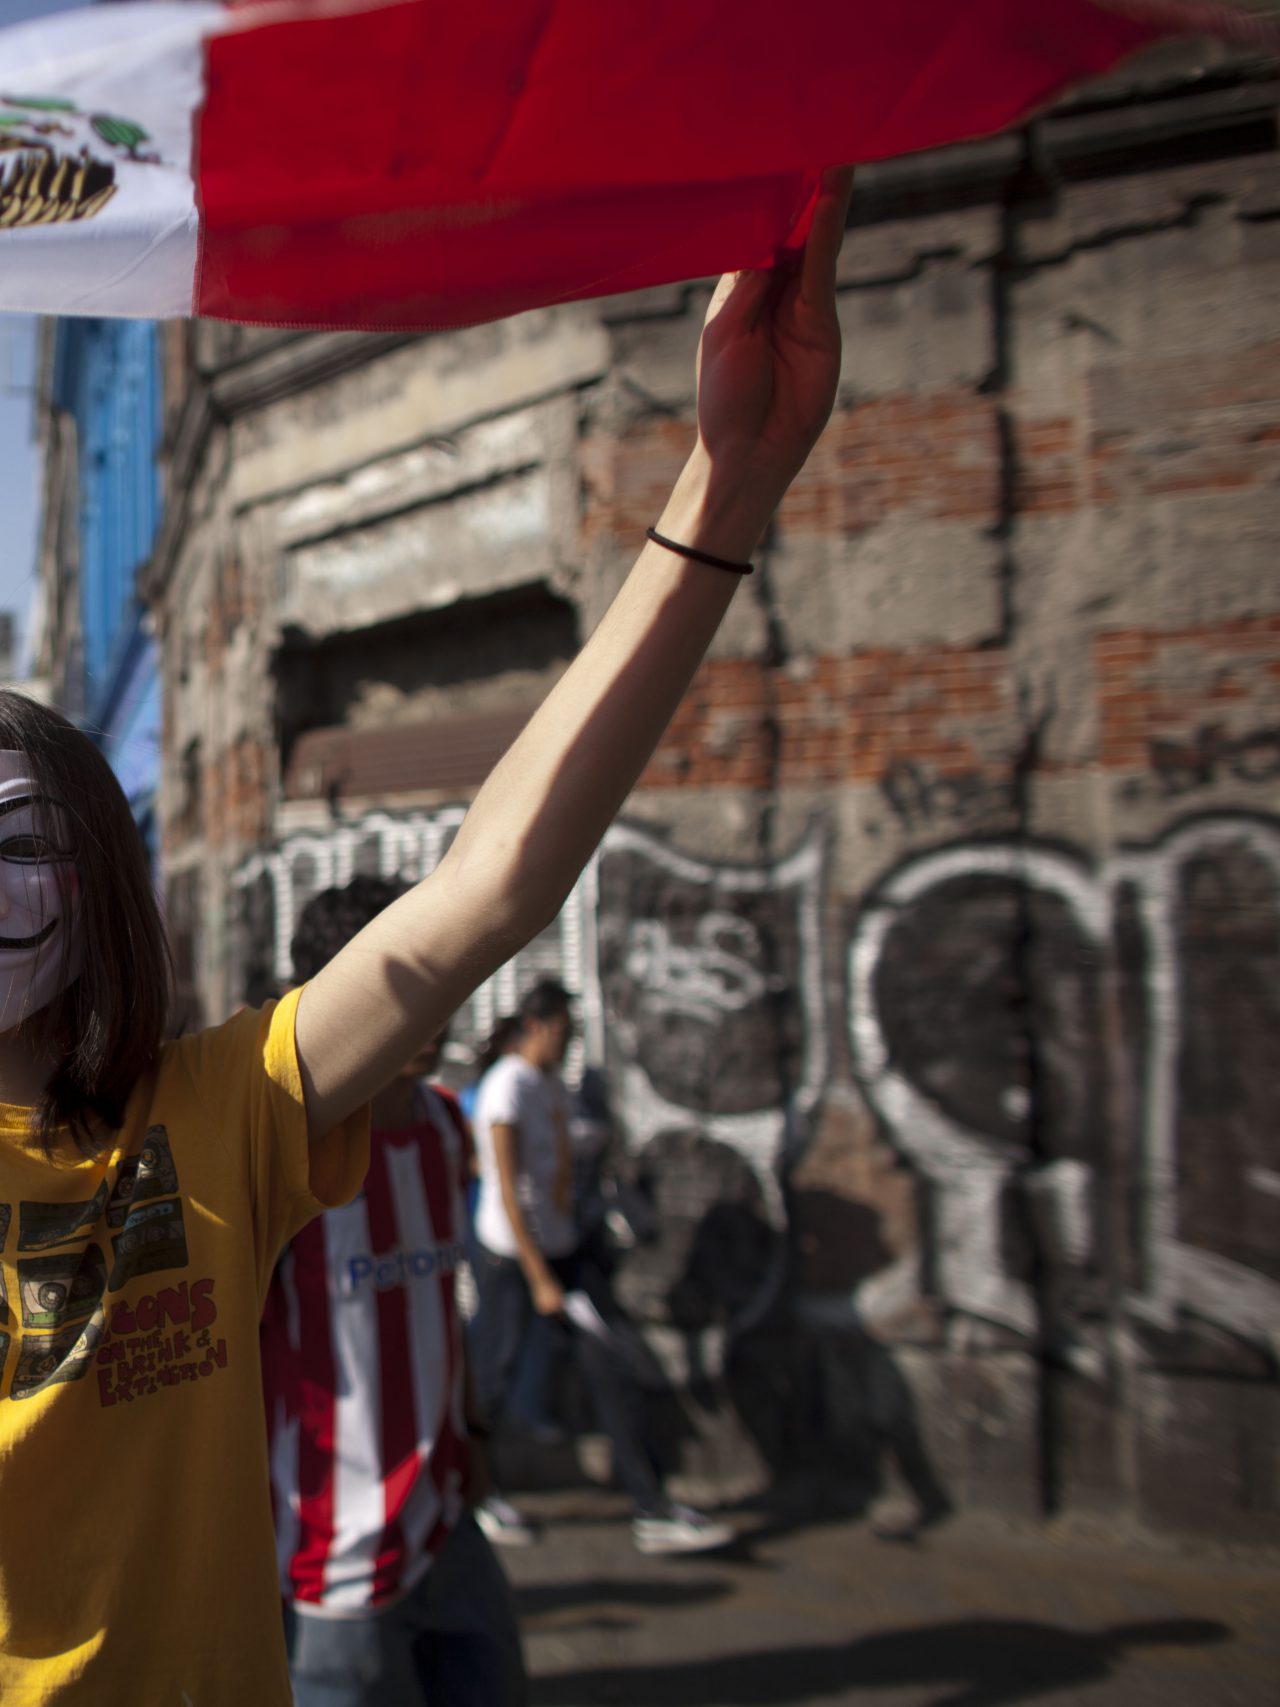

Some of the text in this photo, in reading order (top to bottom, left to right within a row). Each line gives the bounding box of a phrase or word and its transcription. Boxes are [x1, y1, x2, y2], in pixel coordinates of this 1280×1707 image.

[96, 1329, 163, 1365] ON THE
[117, 1330, 191, 1385] BRINK
